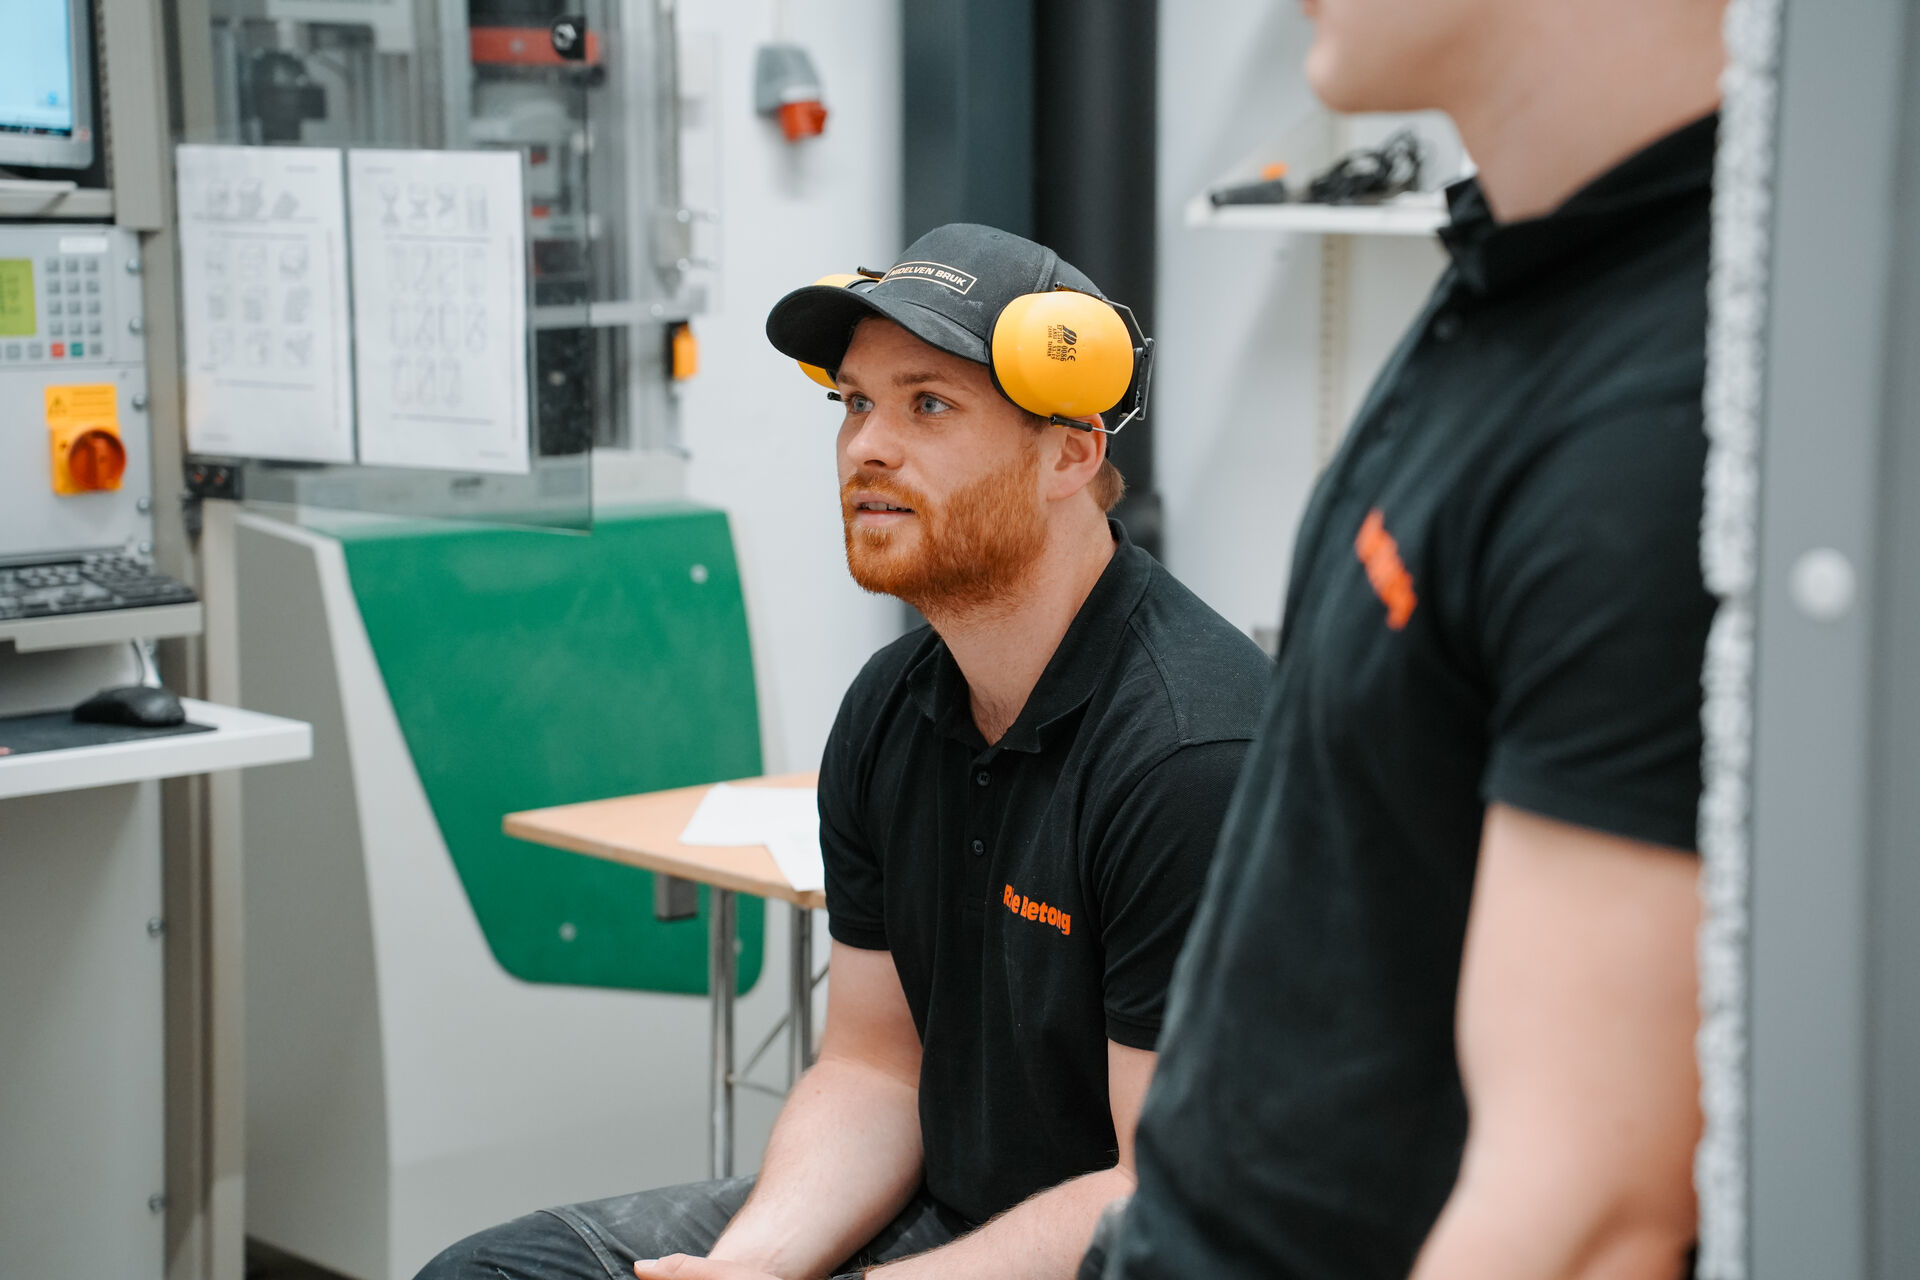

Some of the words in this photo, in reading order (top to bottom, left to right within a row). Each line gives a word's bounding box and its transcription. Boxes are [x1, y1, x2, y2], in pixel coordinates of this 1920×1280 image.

[888, 266, 936, 276] NIDELVEN
[934, 269, 967, 287] BRUK
[1060, 345, 1068, 362] 0086
